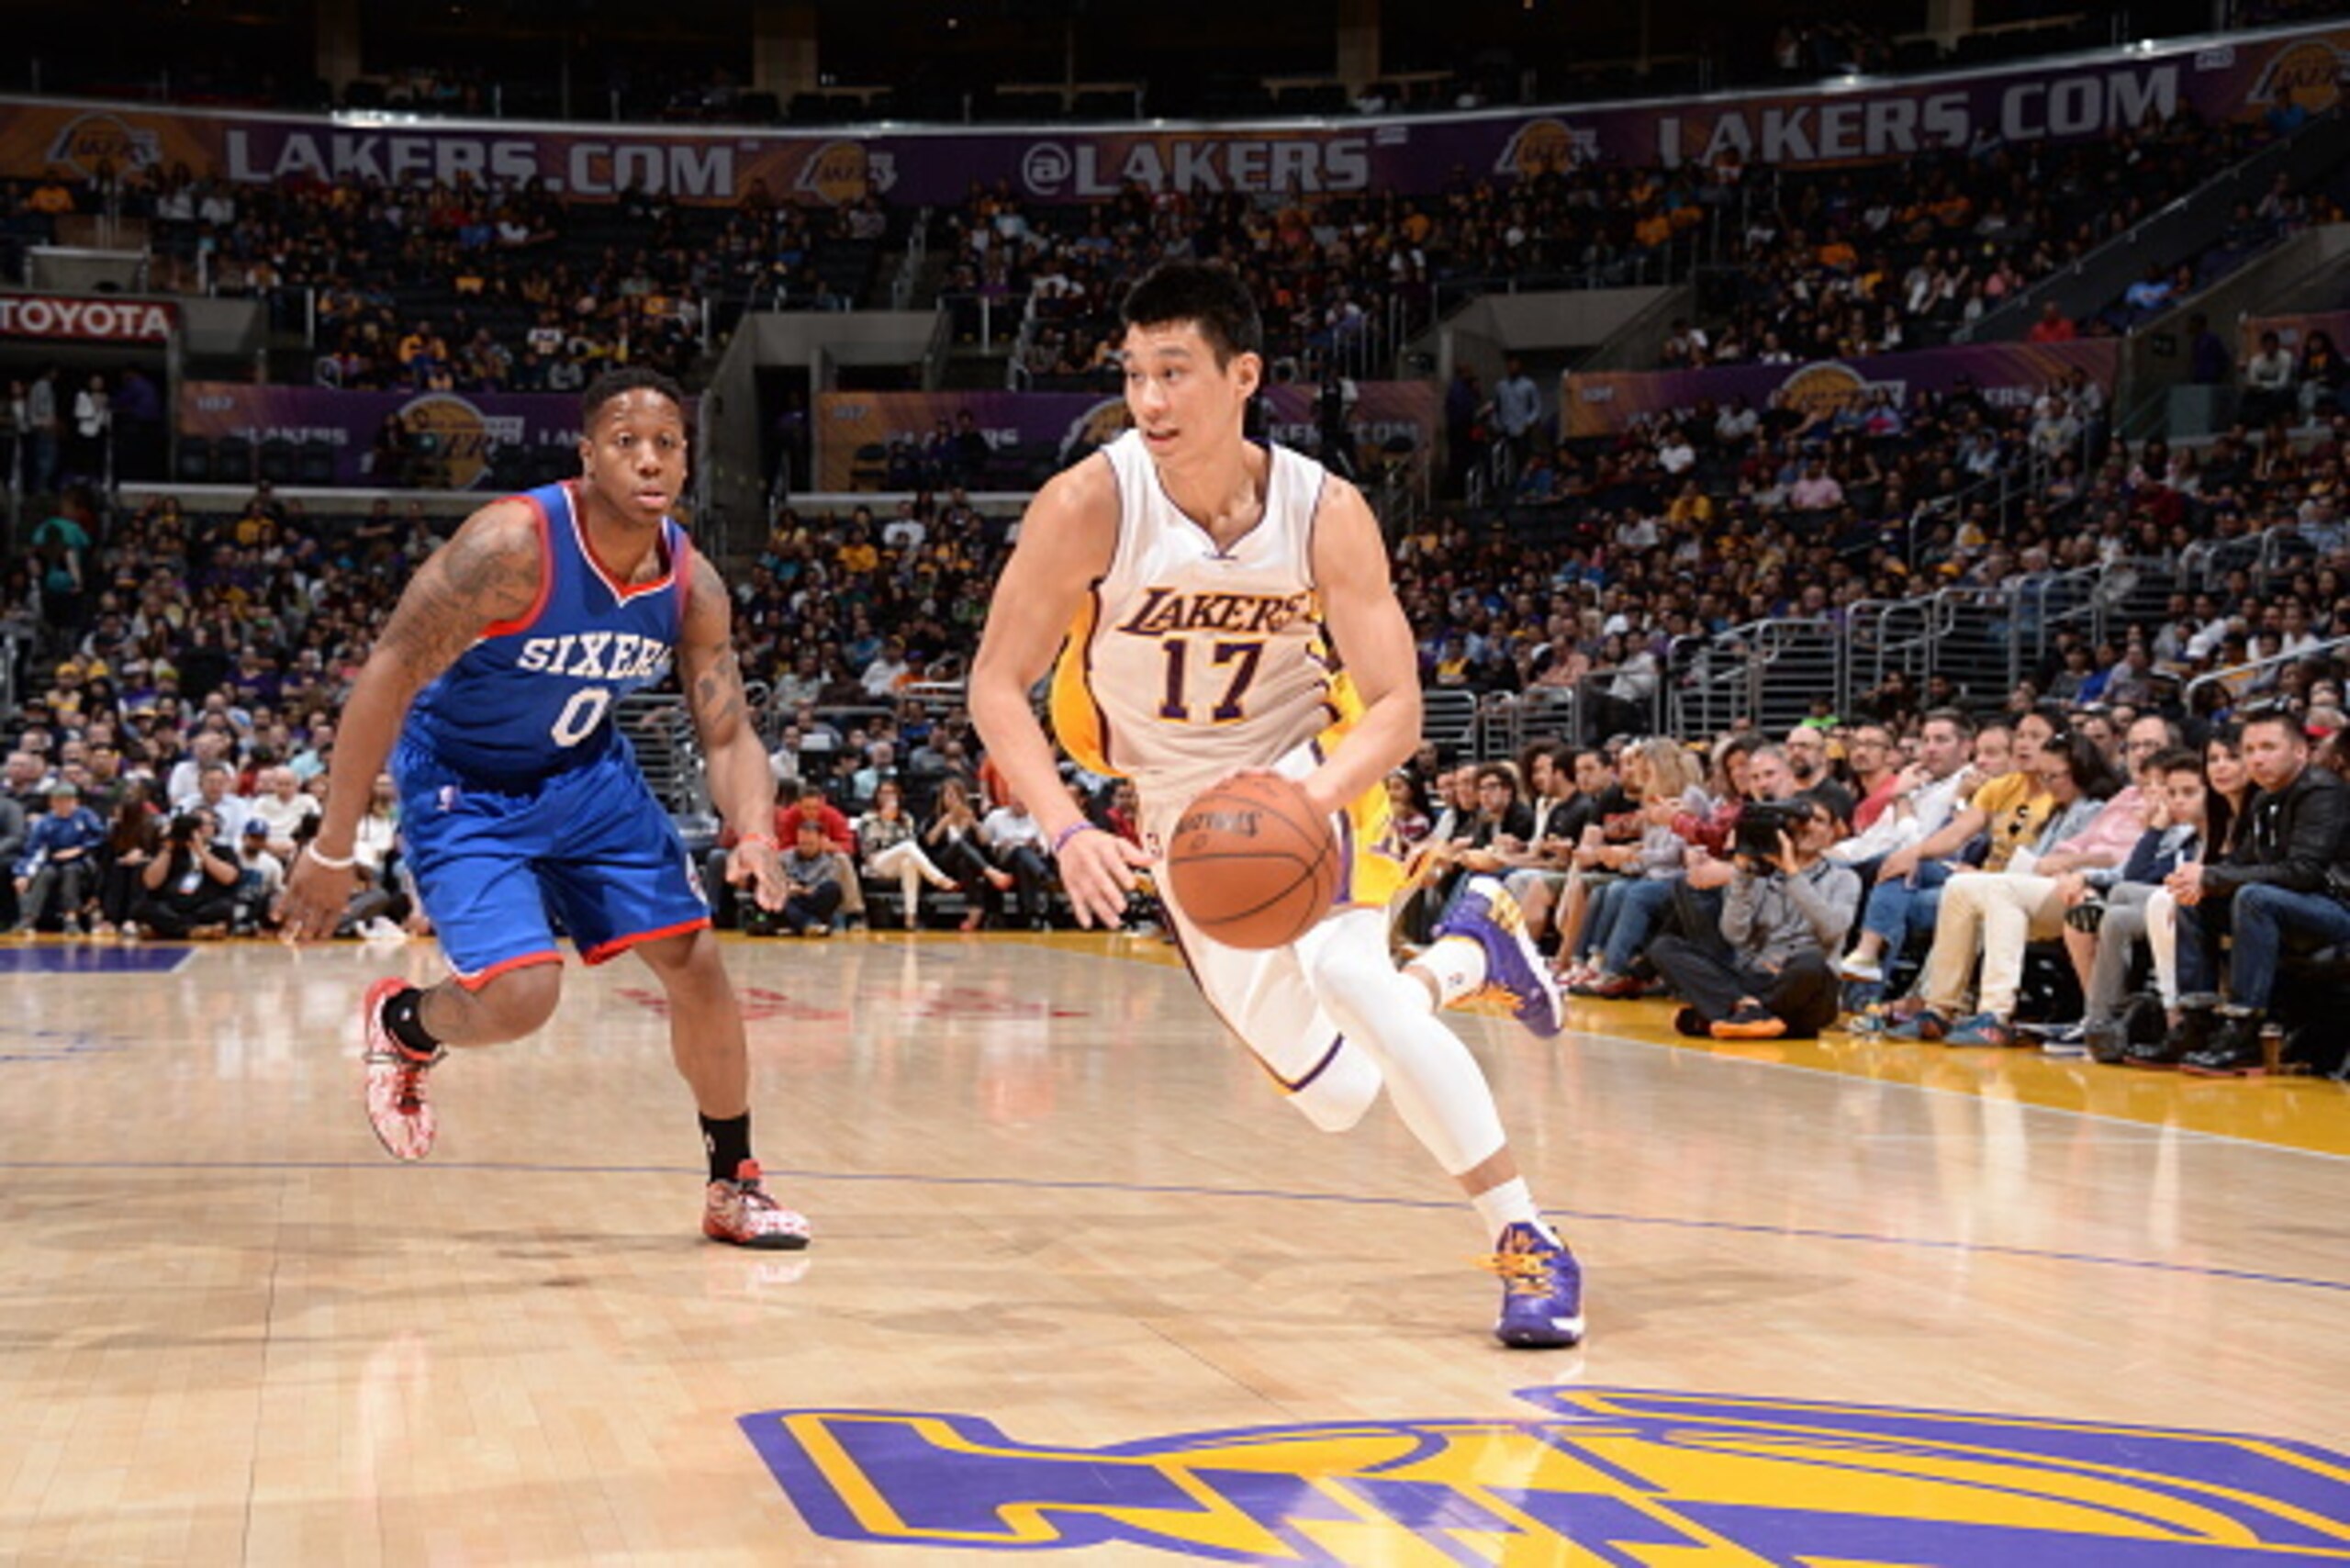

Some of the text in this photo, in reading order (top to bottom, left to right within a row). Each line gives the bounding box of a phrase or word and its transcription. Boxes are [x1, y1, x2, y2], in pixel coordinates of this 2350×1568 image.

[226, 130, 733, 198] LAKERS.COM
[1021, 140, 1370, 196] @LAKERS
[0, 297, 171, 338] TOYOTA
[1158, 638, 1268, 722] 17
[552, 687, 610, 747] 0
